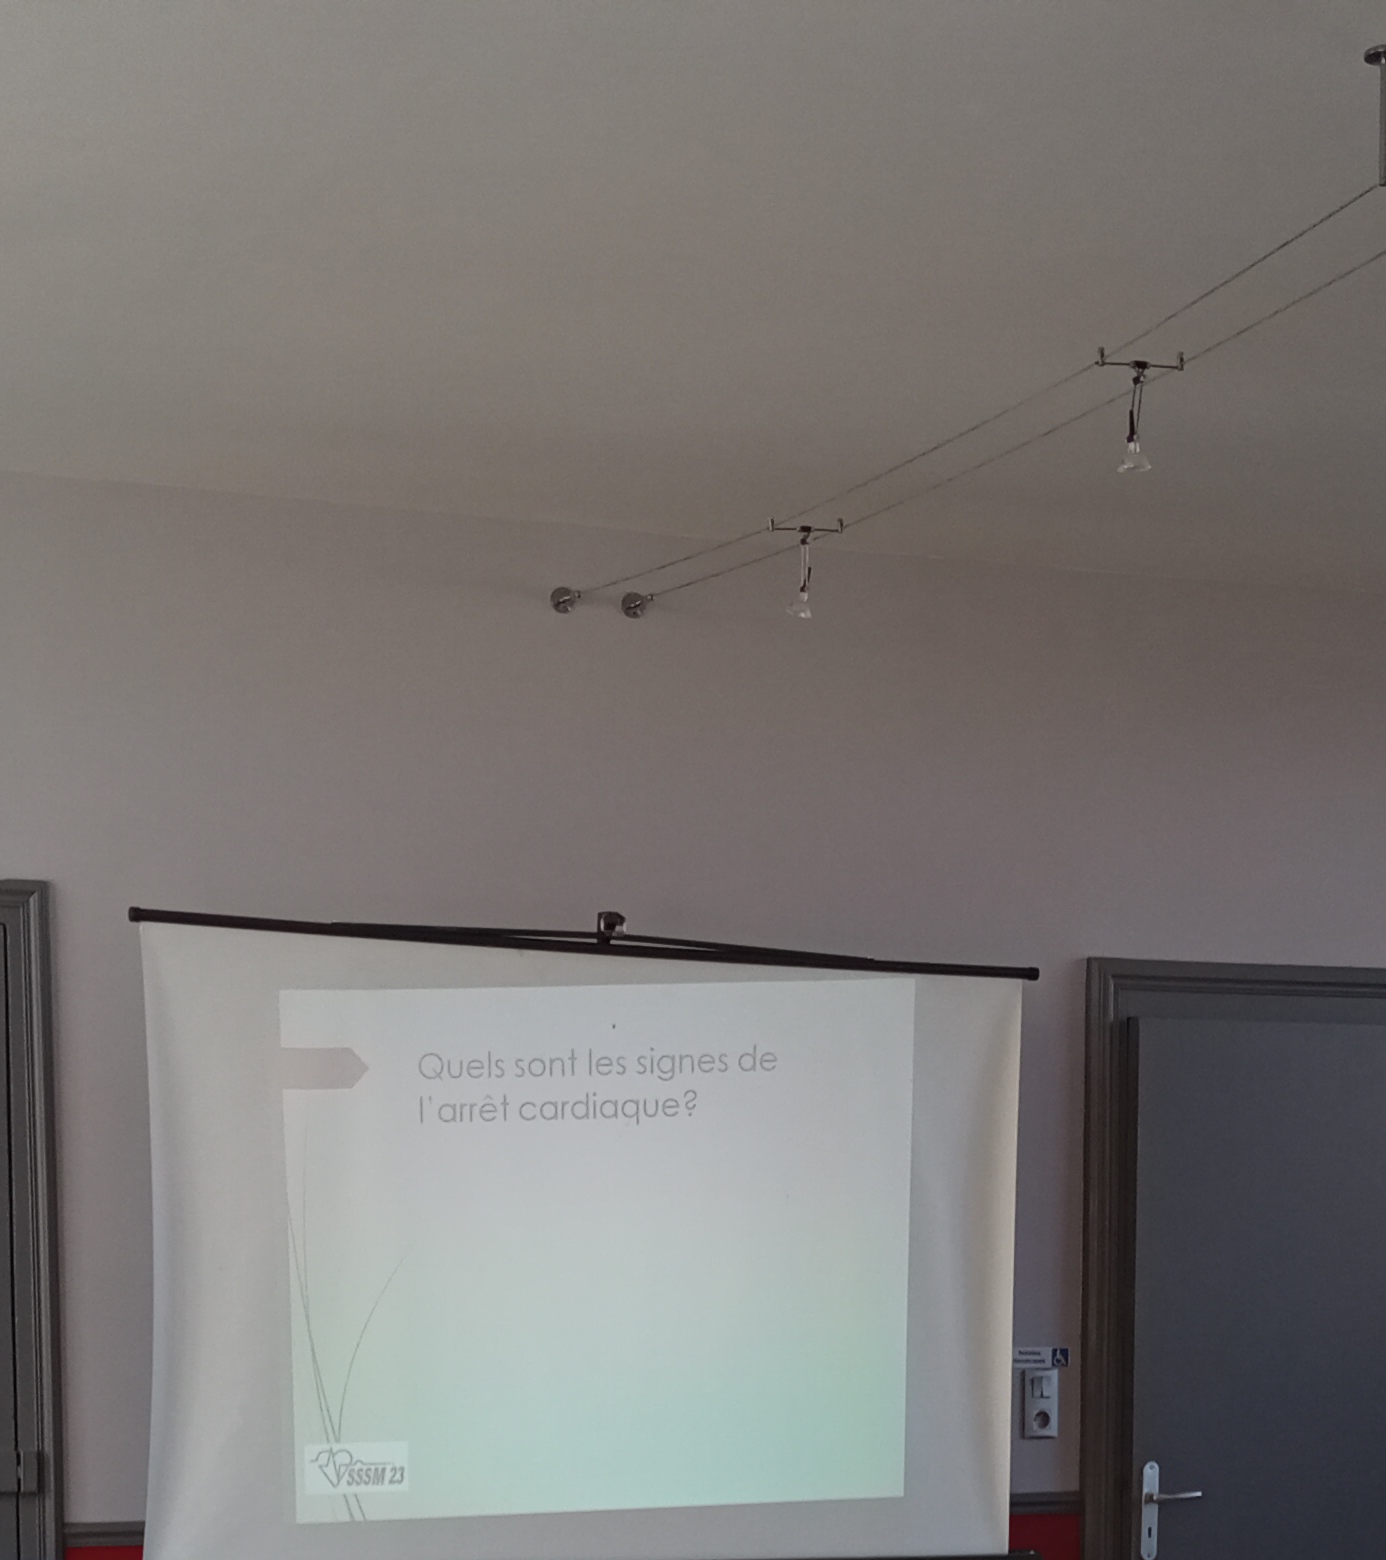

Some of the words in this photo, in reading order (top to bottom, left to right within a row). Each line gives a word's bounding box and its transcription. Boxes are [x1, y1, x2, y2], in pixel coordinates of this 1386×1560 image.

[418, 1051, 506, 1081] Quels
[514, 1048, 577, 1078] sont
[587, 1048, 627, 1076] les
[635, 1047, 729, 1081] signes
[737, 1044, 778, 1073] de
[418, 1093, 509, 1124] l'arrêt
[518, 1089, 699, 1126] cardiaque?
[346, 1466, 387, 1487] SSSM
[388, 1465, 405, 1486] 23
